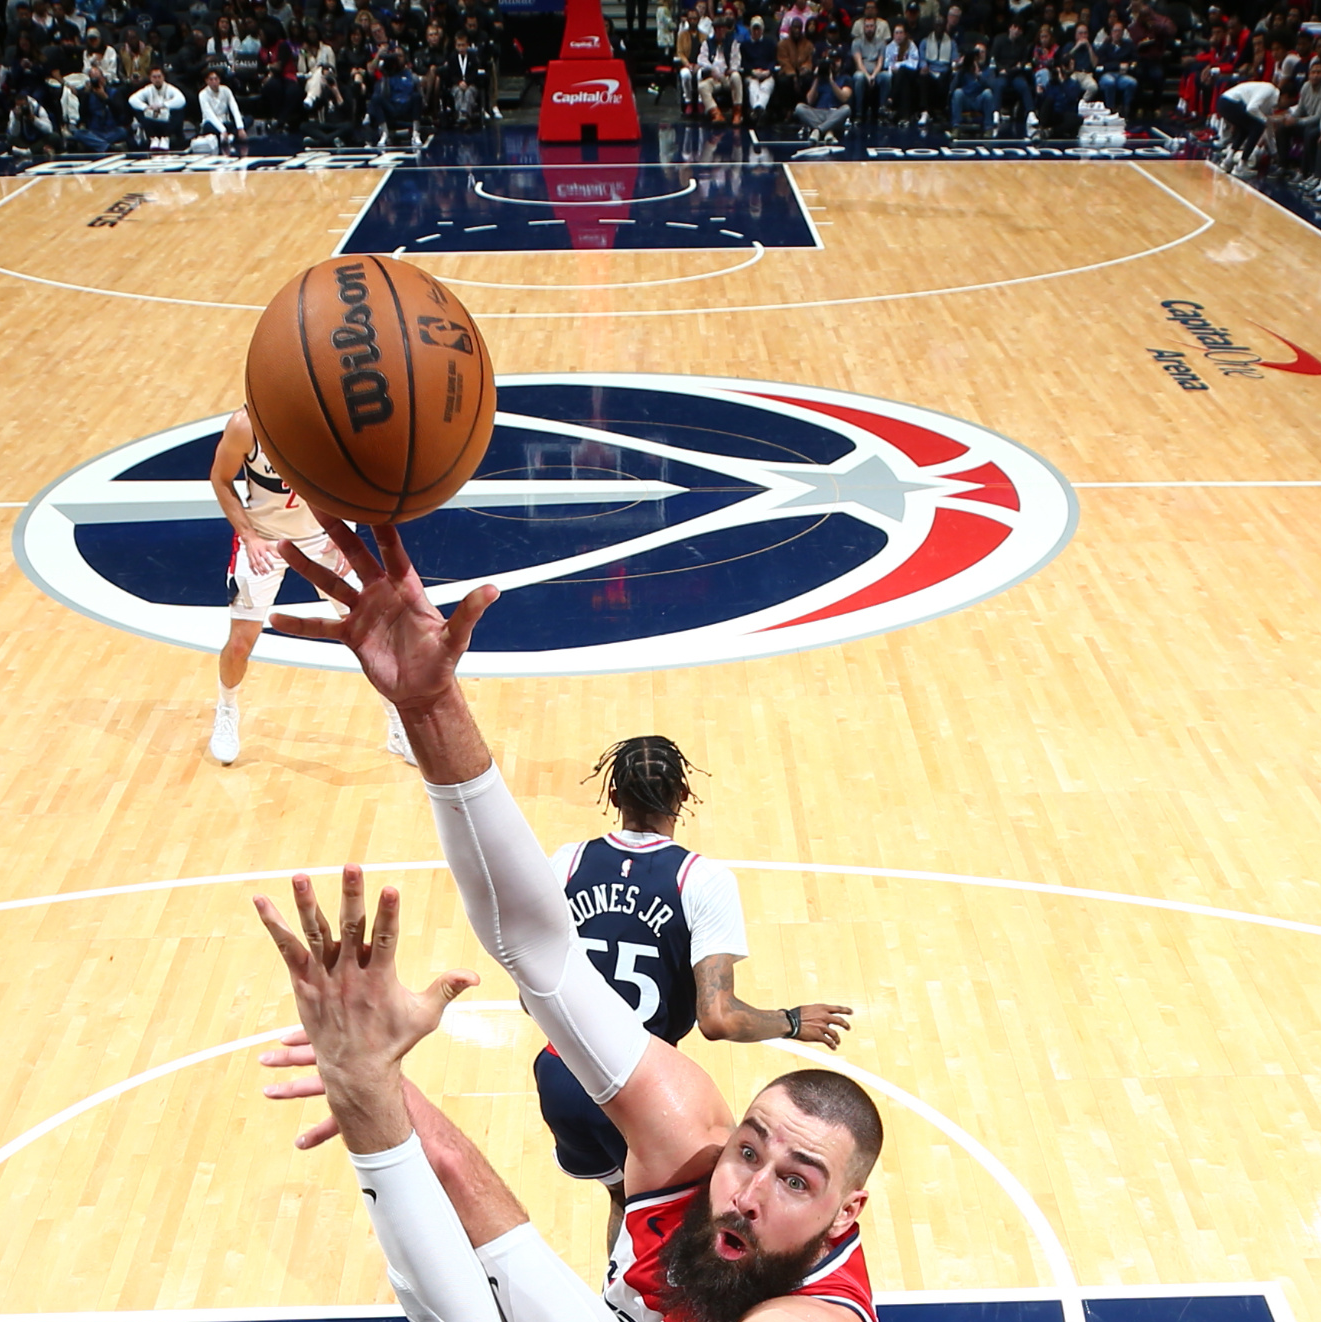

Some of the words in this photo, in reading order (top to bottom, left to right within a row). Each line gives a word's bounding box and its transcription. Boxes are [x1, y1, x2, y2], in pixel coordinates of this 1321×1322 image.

[866, 145, 1172, 158] Robinhood
[331, 262, 394, 435] Wilson
[1146, 348, 1210, 391] Arena
[567, 883, 640, 927] JONES
[638, 896, 675, 937] JR.
